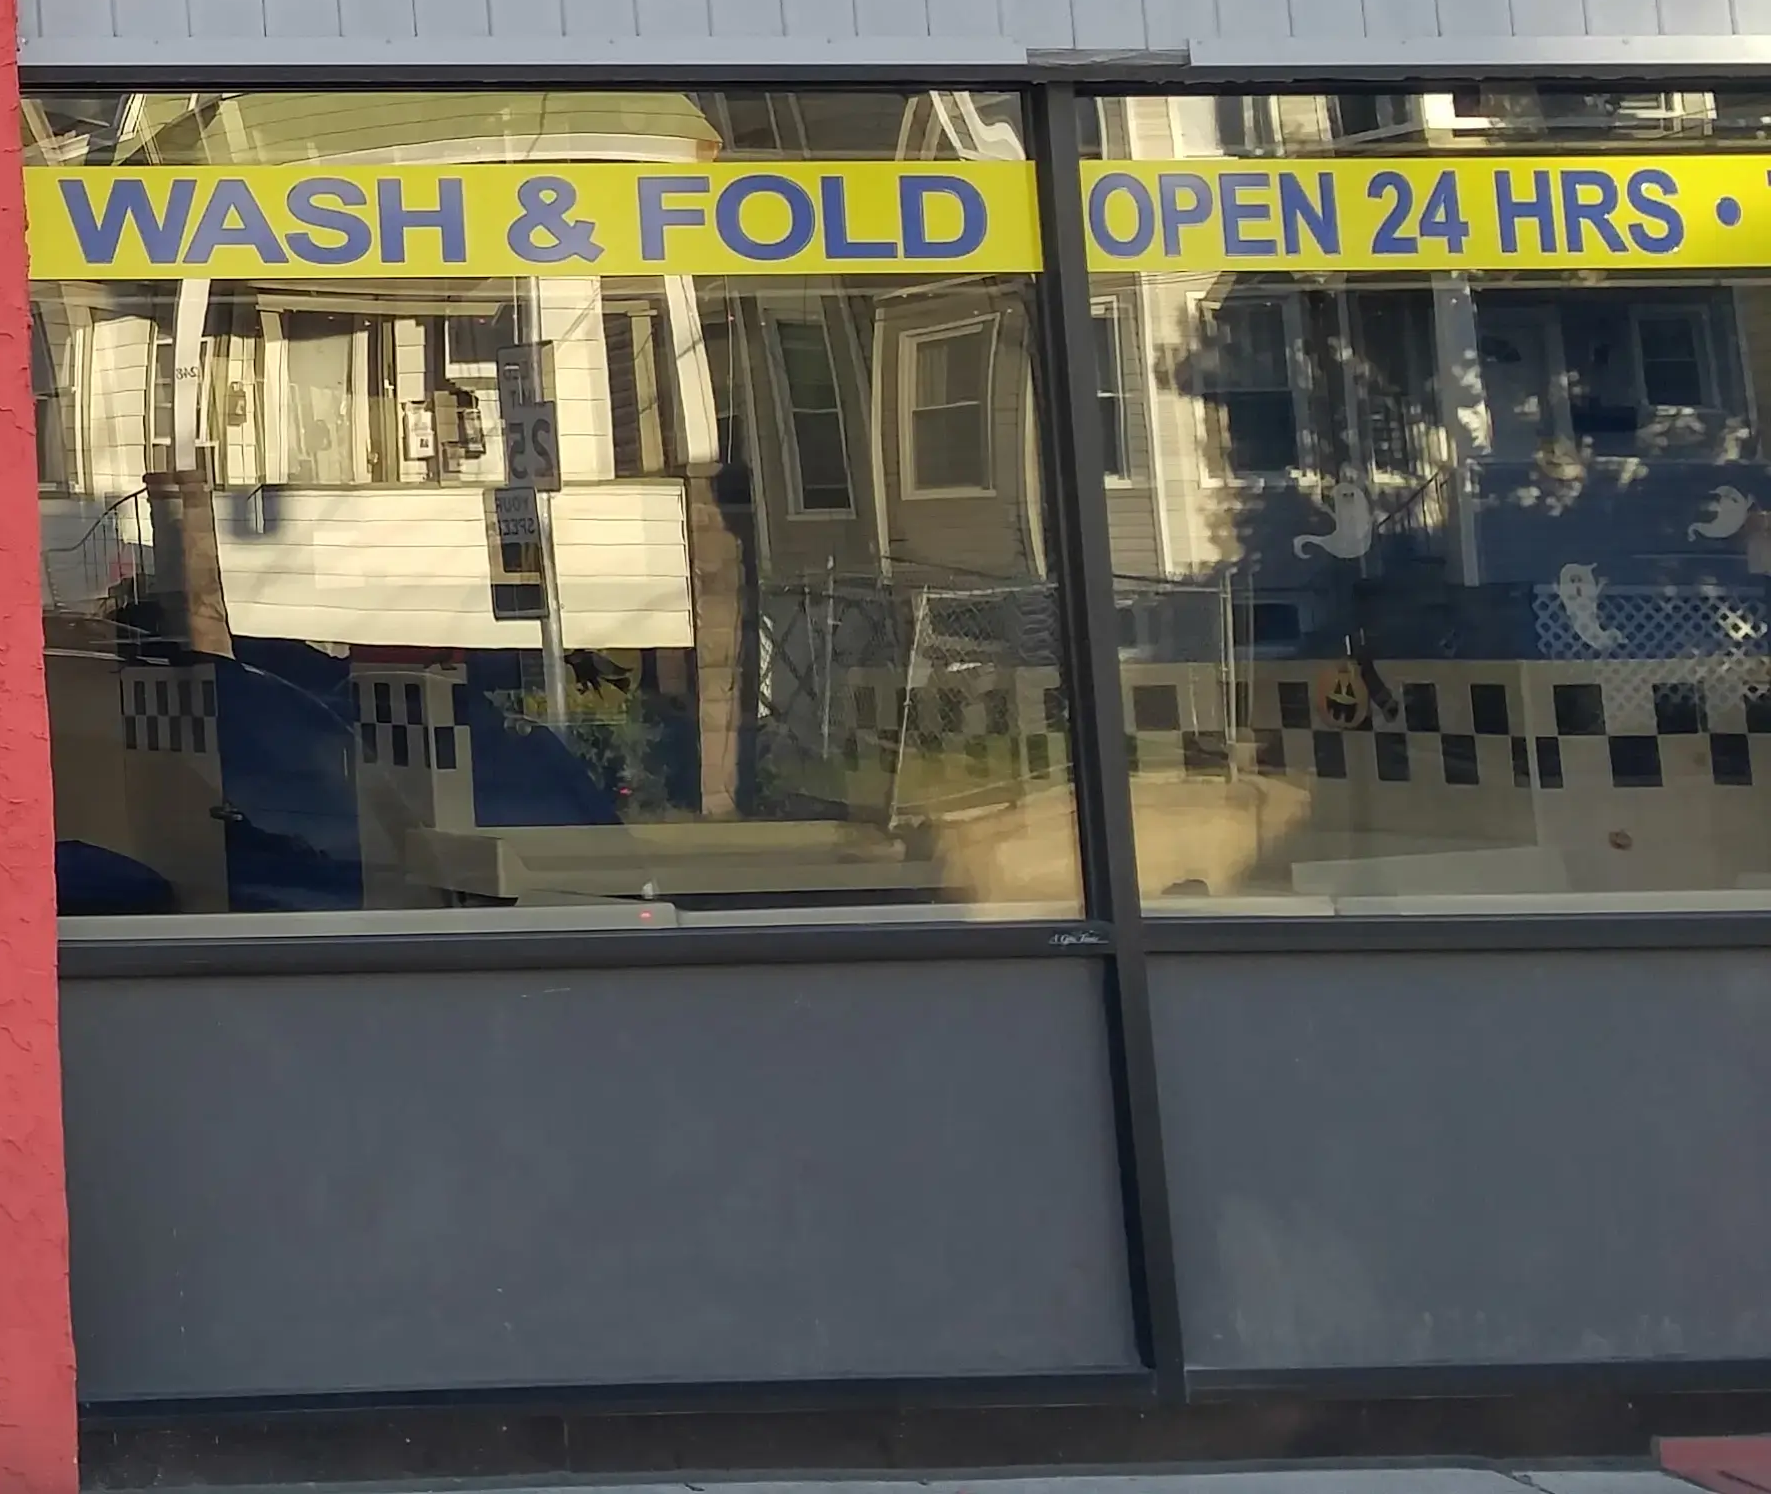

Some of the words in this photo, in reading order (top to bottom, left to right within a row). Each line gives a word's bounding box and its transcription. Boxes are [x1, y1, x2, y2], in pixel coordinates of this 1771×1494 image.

[59, 178, 466, 264] WASH
[507, 176, 604, 263] &
[638, 174, 988, 261] FOLD
[1088, 173, 1339, 258] OPEN
[1367, 171, 1469, 255] 24
[1494, 168, 1685, 255] HRS
